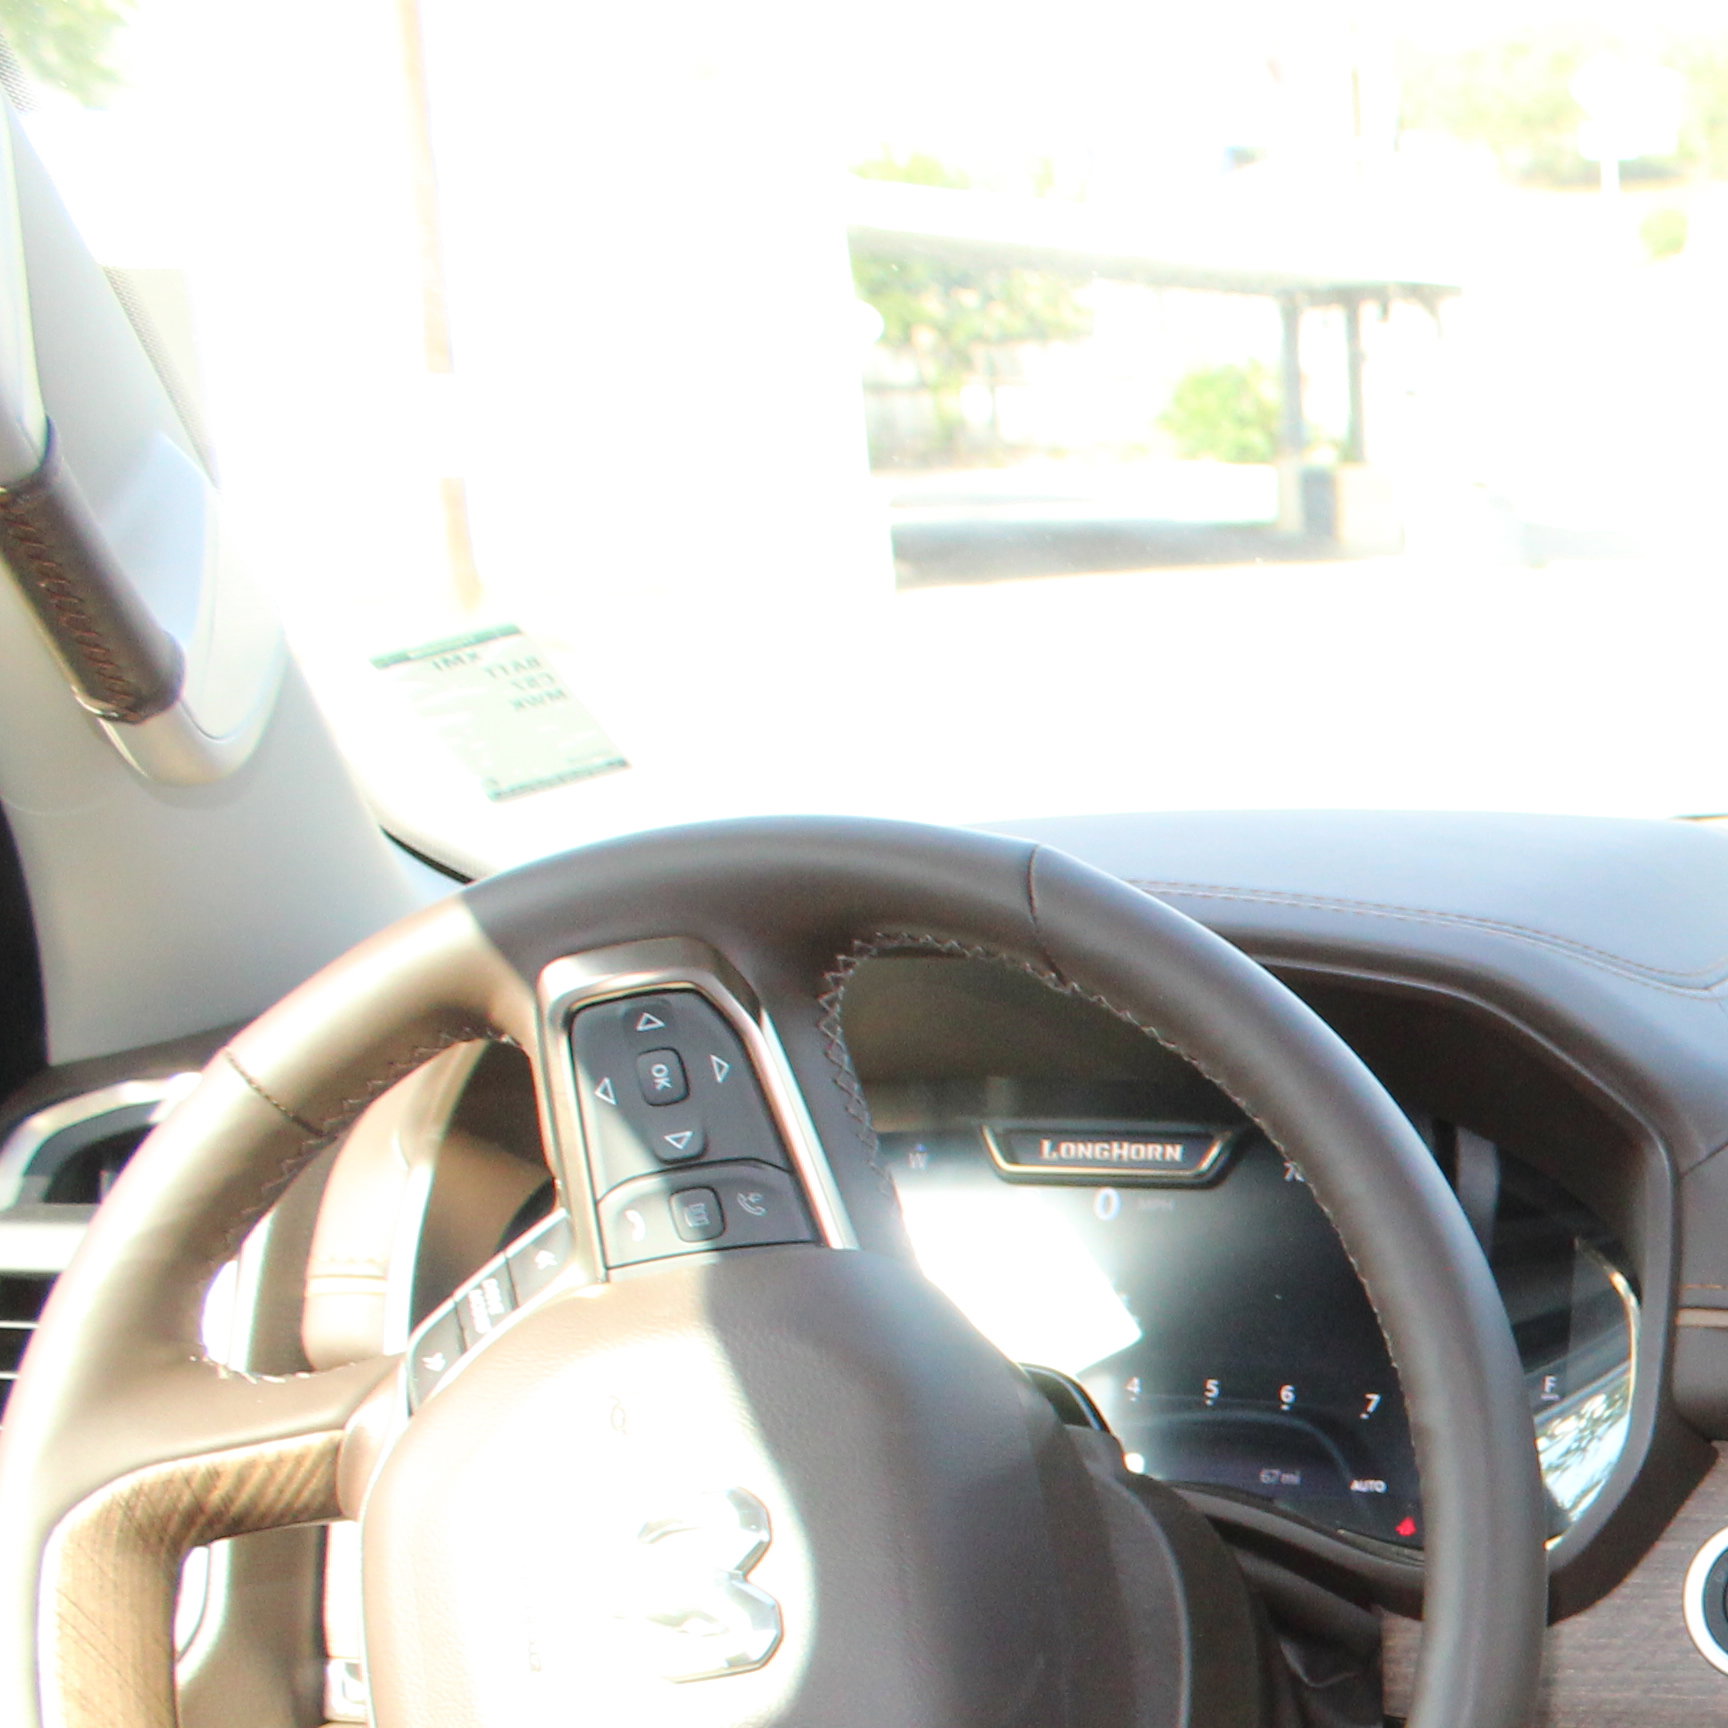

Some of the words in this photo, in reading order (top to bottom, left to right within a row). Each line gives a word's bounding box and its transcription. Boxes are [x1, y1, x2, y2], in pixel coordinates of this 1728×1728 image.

[651, 1063, 672, 1090] OK
[1126, 1376, 1141, 1394] 4
[1205, 1379, 1220, 1398] 5
[1280, 1384, 1295, 1403] 6
[1365, 1393, 1382, 1413] 7
[1350, 1480, 1387, 1493] AUTO
